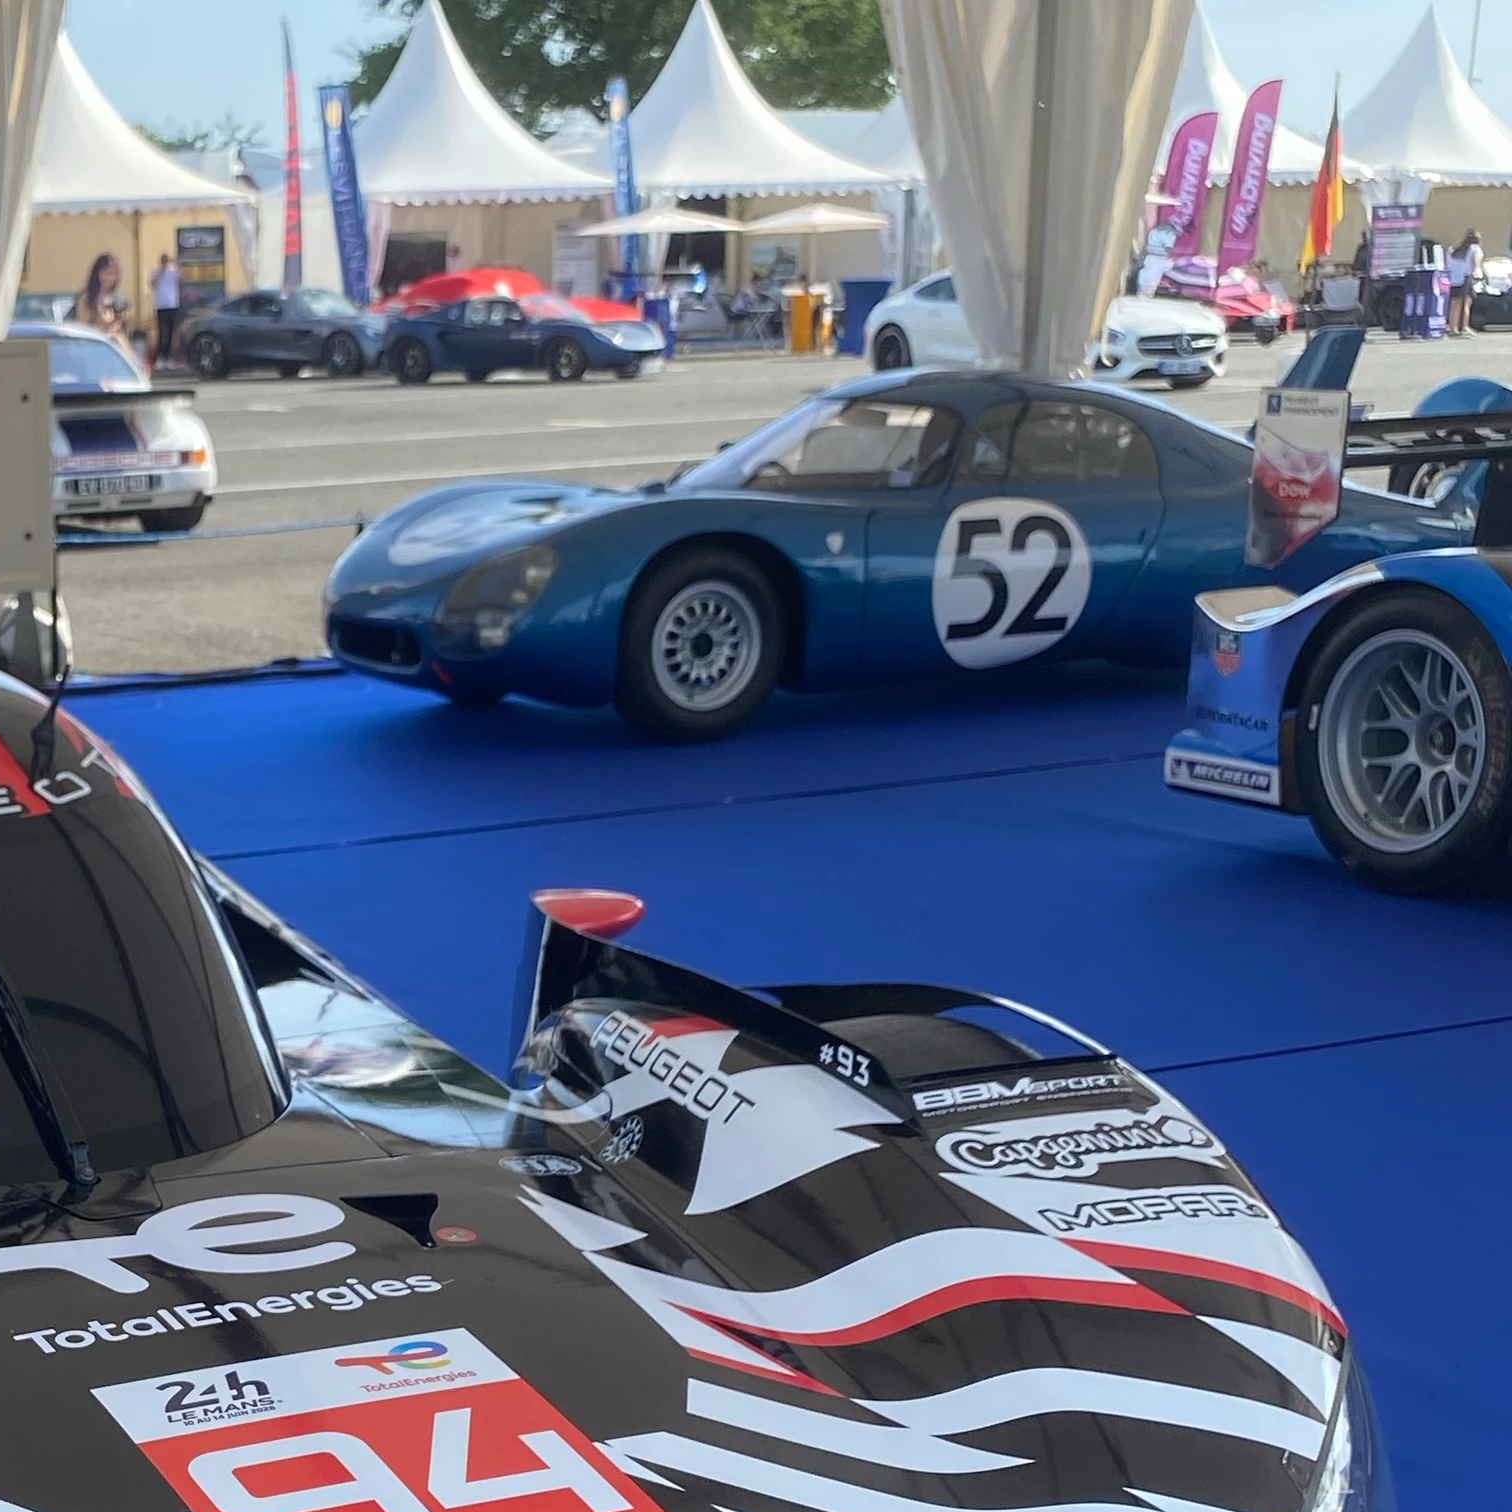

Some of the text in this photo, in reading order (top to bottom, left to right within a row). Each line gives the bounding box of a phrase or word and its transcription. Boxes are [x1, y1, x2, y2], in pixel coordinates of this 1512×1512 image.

[944, 514, 1074, 642] 52
[1191, 764, 1271, 792] MICHELIN
[593, 1013, 757, 1125] PEUGEOT
[819, 1042, 871, 1088] #93
[958, 1119, 1165, 1168] Capgemini
[12, 1271, 444, 1355] TotalEnergies
[155, 1370, 271, 1414] 24h
[360, 1369, 478, 1393] TotalEnergies
[166, 1396, 276, 1424] LE MANS
[197, 1416, 212, 1425] AU
[213, 1414, 226, 1422] 14
[227, 1409, 250, 1420] JUIN
